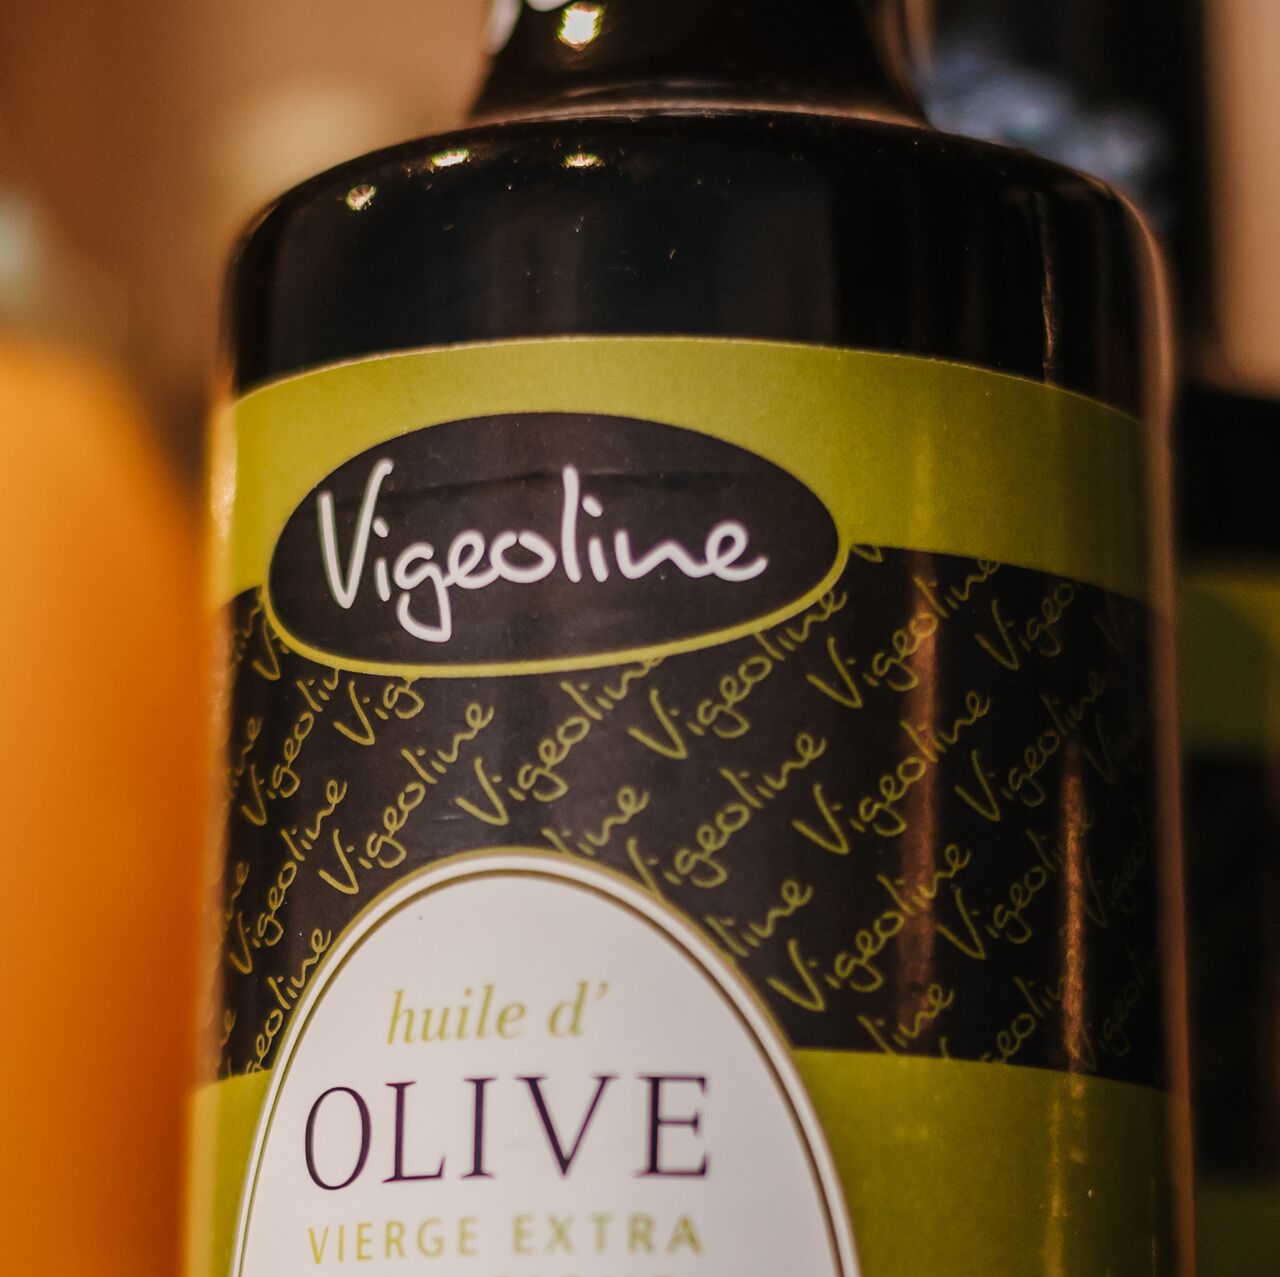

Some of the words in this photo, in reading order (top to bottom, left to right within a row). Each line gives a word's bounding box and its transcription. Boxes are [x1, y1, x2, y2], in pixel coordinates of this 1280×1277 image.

[320, 457, 769, 643] Vigeoline
[319, 702, 494, 896] Vigeoline
[794, 690, 992, 856] Vigeoline
[768, 844, 972, 1013] Vigeoline
[387, 984, 527, 1046] huile
[304, 1073, 711, 1192] OLIVE
[308, 1216, 480, 1266] VIERGE
[512, 1214, 704, 1257] EXTRA
